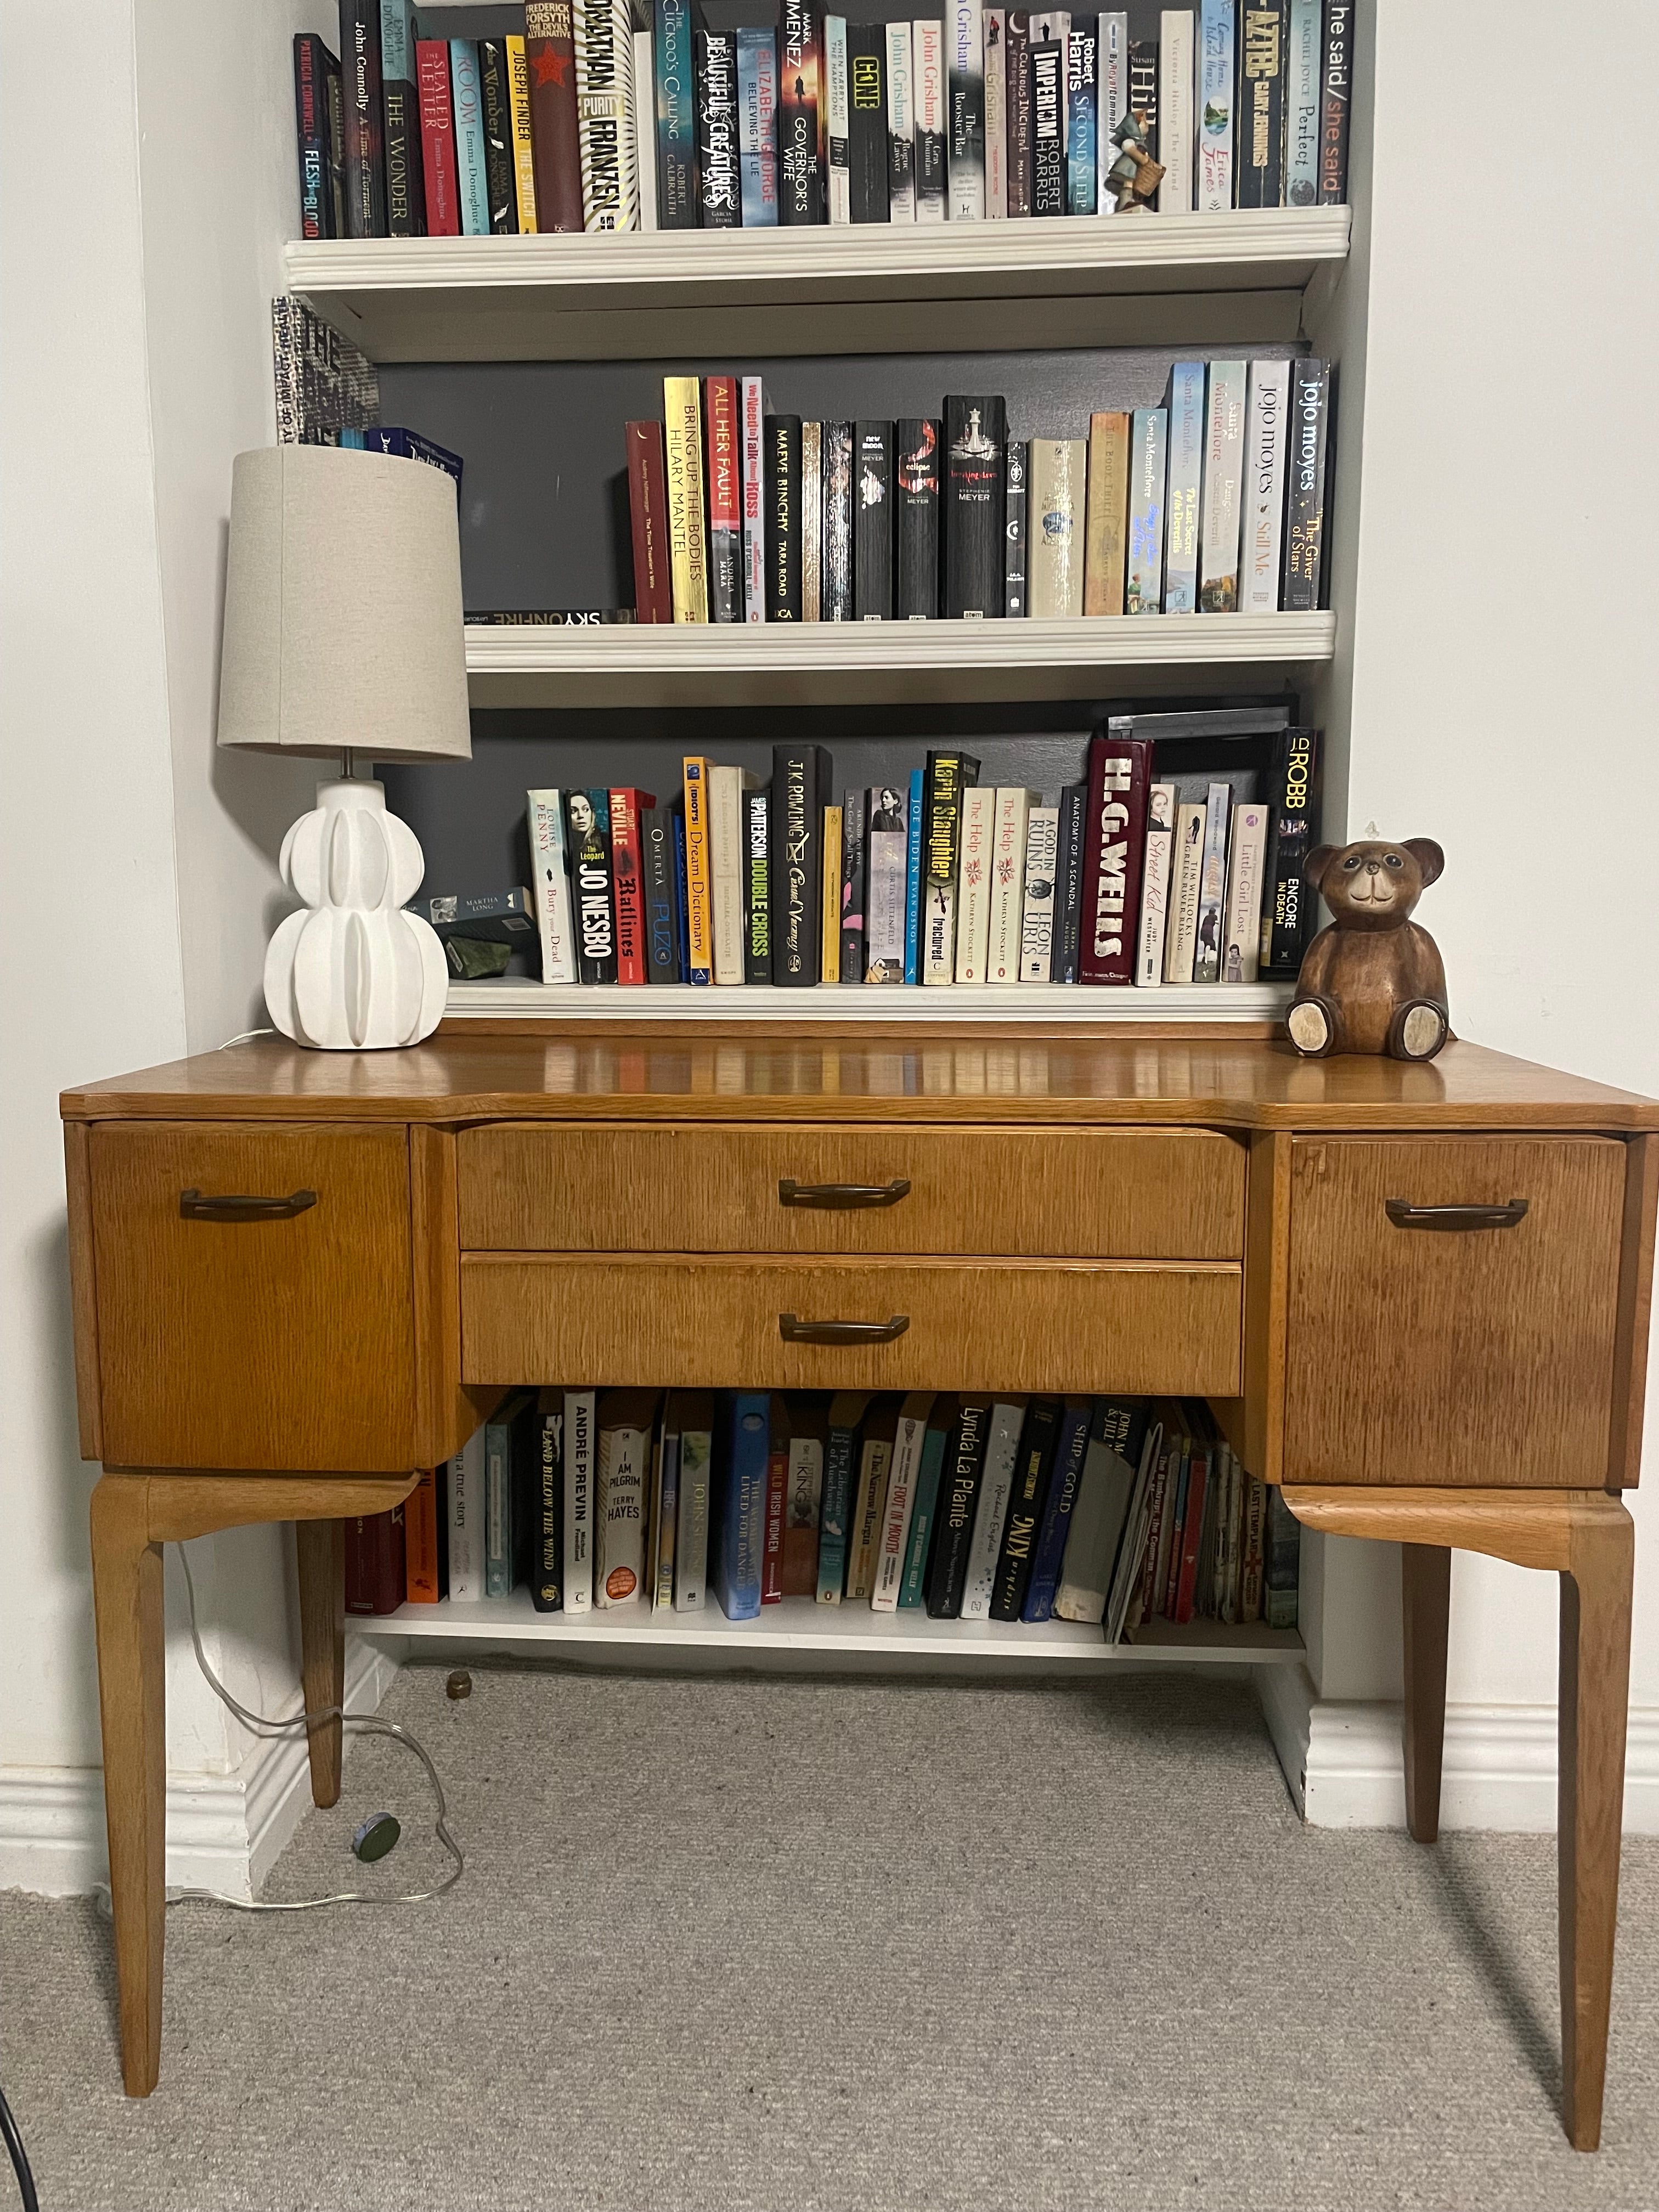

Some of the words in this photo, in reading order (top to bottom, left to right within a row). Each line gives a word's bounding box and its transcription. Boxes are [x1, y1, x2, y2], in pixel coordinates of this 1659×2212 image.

[526, 3, 569, 13] FREDERICK
[526, 13, 570, 24] FORSYTH
[803, 13, 811, 44] MARK
[356, 22, 366, 52] John
[891, 32, 906, 65] John
[922, 29, 937, 63] John
[957, 8, 972, 73] Grisham
[1246, 10, 1279, 77] AZTEC
[1302, 19, 1312, 59] RACHEL
[513, 51, 528, 94] JOSEPH
[1069, 32, 1085, 92] Harris
[1084, 38, 1094, 84] Robert
[1301, 63, 1310, 97] JOYCE
[356, 57, 369, 111] Connolly
[422, 64, 437, 128] LETTER
[434, 60, 449, 129] SEALED
[457, 57, 476, 126] ROOM
[854, 58, 879, 108] GONE
[893, 70, 907, 128] Grisham
[924, 66, 938, 125] Grisham
[1034, 51, 1057, 138] IMPERIUM
[388, 94, 404, 127] THE
[517, 99, 531, 140] FINDER
[584, 97, 621, 116] PURITY
[748, 83, 758, 135] BELIEVING
[955, 92, 966, 135] Rooster
[966, 112, 976, 135] The
[466, 131, 475, 163] Emma
[955, 137, 966, 156] Bar
[1295, 104, 1315, 166] Perfect
[390, 137, 408, 219] WONDER
[589, 121, 620, 210] FRANZEN
[783, 147, 794, 180] WIFE
[795, 117, 808, 212] GOVERNOR'S
[808, 155, 816, 174] THE
[1036, 140, 1048, 210] HARRIS
[1048, 139, 1060, 209] ROBERT
[1323, 146, 1342, 191] said
[469, 168, 480, 224] Donoghue
[521, 174, 535, 217] SWITCH
[667, 154, 676, 215] GALBRAITH
[715, 385, 729, 416] ALL
[1184, 374, 1194, 406] Santa
[1258, 384, 1282, 425] jojo
[1299, 380, 1323, 421] jojo
[684, 405, 697, 455] BRING
[716, 420, 731, 453] HER
[670, 430, 683, 487] HILARY
[686, 461, 698, 482] UP
[777, 429, 788, 473] MAEVE
[1255, 430, 1275, 494] moyes
[1296, 425, 1317, 491] moyes
[687, 487, 698, 518] THE
[717, 458, 732, 509] FAULT
[777, 478, 789, 531] BINCHY
[672, 493, 686, 558] MANTEL
[1256, 521, 1271, 548] Still
[1305, 517, 1320, 542] The
[689, 524, 701, 580] BODIES
[1255, 553, 1269, 576] Me
[1304, 546, 1319, 580] Giver
[934, 759, 958, 800] Karin
[1286, 753, 1309, 809] ROBB
[611, 794, 628, 845] NEVILLE
[911, 799, 921, 822] JOE
[971, 800, 981, 819] The
[1003, 798, 1014, 817] The
[537, 804, 549, 853] PENNY
[547, 809, 556, 848] LOUISE
[751, 803, 768, 859] PATTERSON
[967, 824, 983, 853] Help
[1000, 822, 1015, 851] Help
[1027, 820, 1045, 871] RUINS
[1045, 829, 1056, 855] GOD
[580, 851, 605, 861] Leopard
[651, 828, 665, 885] OMERTA
[690, 831, 703, 877] Dream
[911, 831, 920, 872] BIDEN
[1044, 859, 1054, 871] IN
[1071, 844, 1078, 856] OF
[1147, 834, 1165, 881] Street
[1190, 861, 1198, 879] TIM
[1240, 844, 1252, 877] Little
[579, 864, 608, 889] JO
[752, 860, 768, 910] DOUBLE
[1068, 868, 1076, 910] SCANDAL
[1239, 880, 1250, 904] Girl
[1278, 882, 1286, 893] IN
[466, 897, 499, 906] MARTHA
[547, 889, 557, 915] Bury
[692, 882, 705, 951] Dictionary
[1147, 885, 1164, 913] Kid
[1180, 883, 1188, 913] RIVER
[1185, 883, 1196, 936] WILLOCKS
[1276, 894, 1286, 925] DEATH
[1285, 878, 1300, 929] ENCORE
[582, 895, 612, 958] NESBO
[652, 904, 672, 966] PUZO
[752, 913, 768, 957] CROSS
[888, 901, 896, 945] SITTENFELD
[932, 918, 945, 960] fractured
[1023, 912, 1039, 955] URIS
[1037, 912, 1052, 955] LEON
[1177, 916, 1186, 951] RISING
[1237, 909, 1248, 934] Lost
[551, 935, 562, 963] Dead
[960, 1407, 984, 1452] Lynda
[1071, 1424, 1087, 1458] SHIP
[610, 1476, 640, 1489] PILGRIM
[618, 1463, 631, 1474] AM
[772, 1464, 785, 1488] WILD
[873, 1454, 884, 1471] The
[957, 1456, 977, 1473] La
[543, 1465, 554, 1509] BELOW
[575, 1464, 588, 1521] PREVIN
[613, 1496, 635, 1505] TERRY
[692, 1483, 706, 1522] JOHN
[740, 1476, 751, 1510] LIVED
[769, 1491, 782, 1516] IRISH
[795, 1466, 809, 1503] KING
[836, 1470, 848, 1515] Librarian
[949, 1479, 974, 1528] Plante
[1059, 1472, 1076, 1514] GOLD
[543, 1511, 554, 1534] THE
[608, 1506, 639, 1521] HAYES
[738, 1515, 748, 1538] FOR
[768, 1516, 781, 1552] WOMEN
[861, 1510, 877, 1545] Margin
[543, 1536, 554, 1570] WIND
[886, 1523, 902, 1554] MOUTH
[1006, 1514, 1035, 1559] KING
